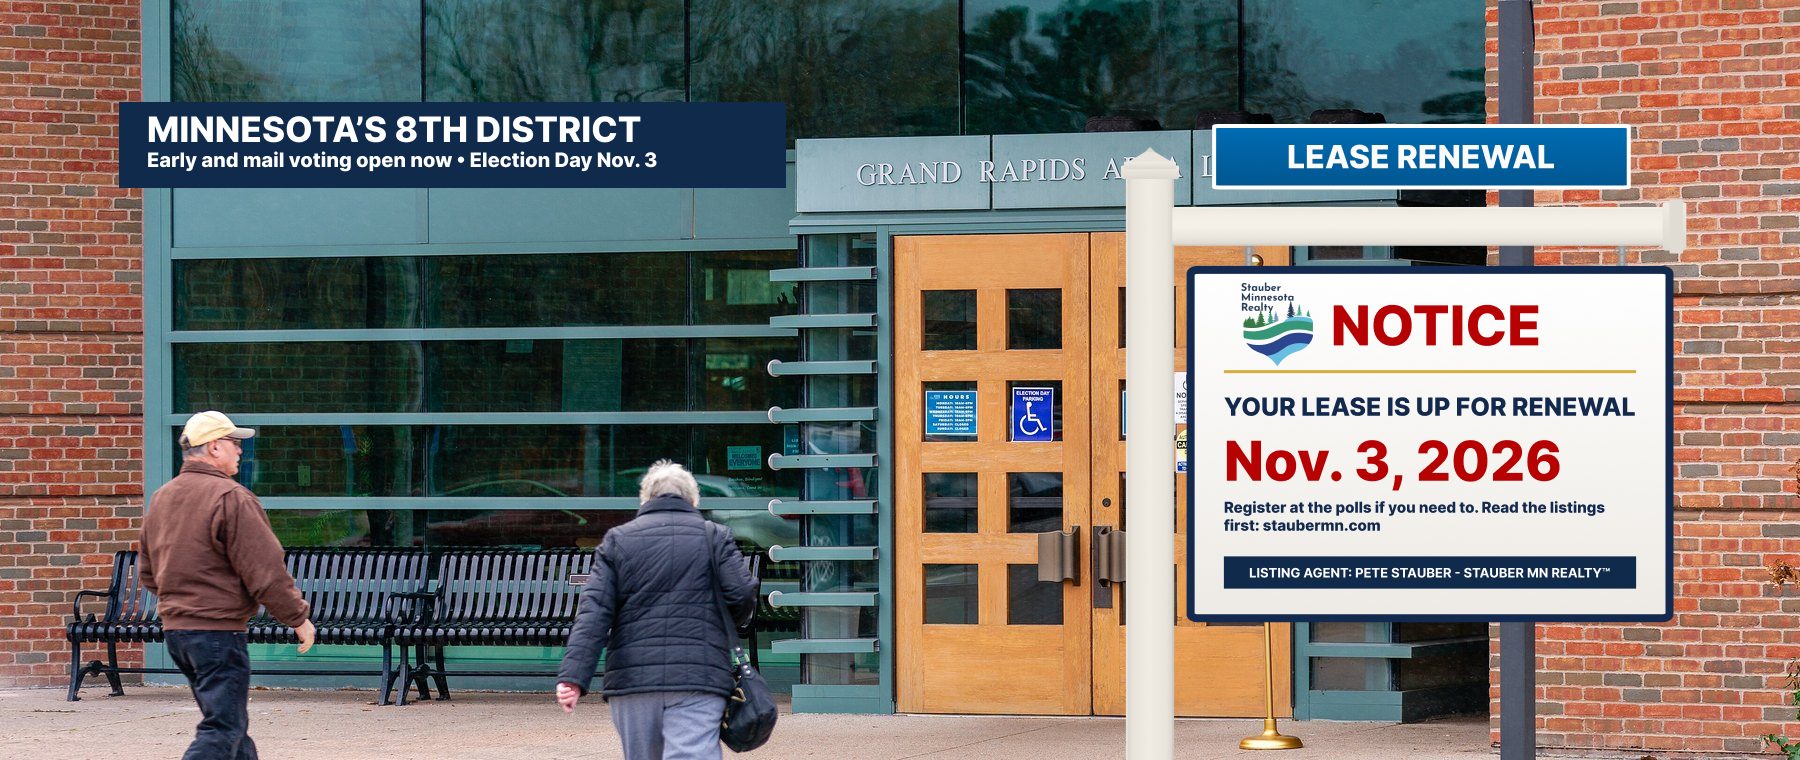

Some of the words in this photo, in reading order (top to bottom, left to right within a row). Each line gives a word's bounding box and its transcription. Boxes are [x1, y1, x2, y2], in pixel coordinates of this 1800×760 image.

[1288, 144, 1389, 170] LEASE
[1397, 144, 1555, 169] RENEWAL
[856, 161, 963, 187] GRAND
[979, 157, 1087, 184] RAPIDS
[1241, 282, 1282, 292] Stauber
[1241, 292, 1294, 302] Minnesota
[1241, 302, 1274, 313] Realty
[1333, 304, 1539, 347] NOTICE
[1224, 396, 1296, 417] YOUR
[1301, 396, 1381, 417] LEASE
[1387, 396, 1411, 417] IS
[1416, 396, 1450, 417] UP
[1456, 396, 1507, 417] FOR
[1512, 396, 1636, 417] RENEWAL
[1226, 440, 1342, 482] Nov.
[1355, 439, 1403, 492] 3,
[1417, 439, 1561, 482] 2026
[1224, 501, 1287, 517] Register
[1289, 501, 1305, 514] at
[1308, 501, 1333, 514] the
[1335, 501, 1372, 517] polls
[1375, 501, 1386, 514] if
[1388, 503, 1416, 517] you
[1419, 501, 1456, 514] need
[1458, 501, 1479, 514] to.
[1481, 501, 1519, 514] Read
[1521, 501, 1547, 514] the
[1550, 501, 1606, 517] listings
[1223, 518, 1259, 532] first:
[1262, 519, 1381, 532] staubermn.com
[1249, 567, 1301, 579] LISTING
[1303, 567, 1352, 579] AGENT:
[1355, 567, 1388, 579] PETE
[1391, 567, 1452, 579] STAUBER
[1463, 567, 1524, 579] STAUBER
[1527, 567, 1549, 579] MN
